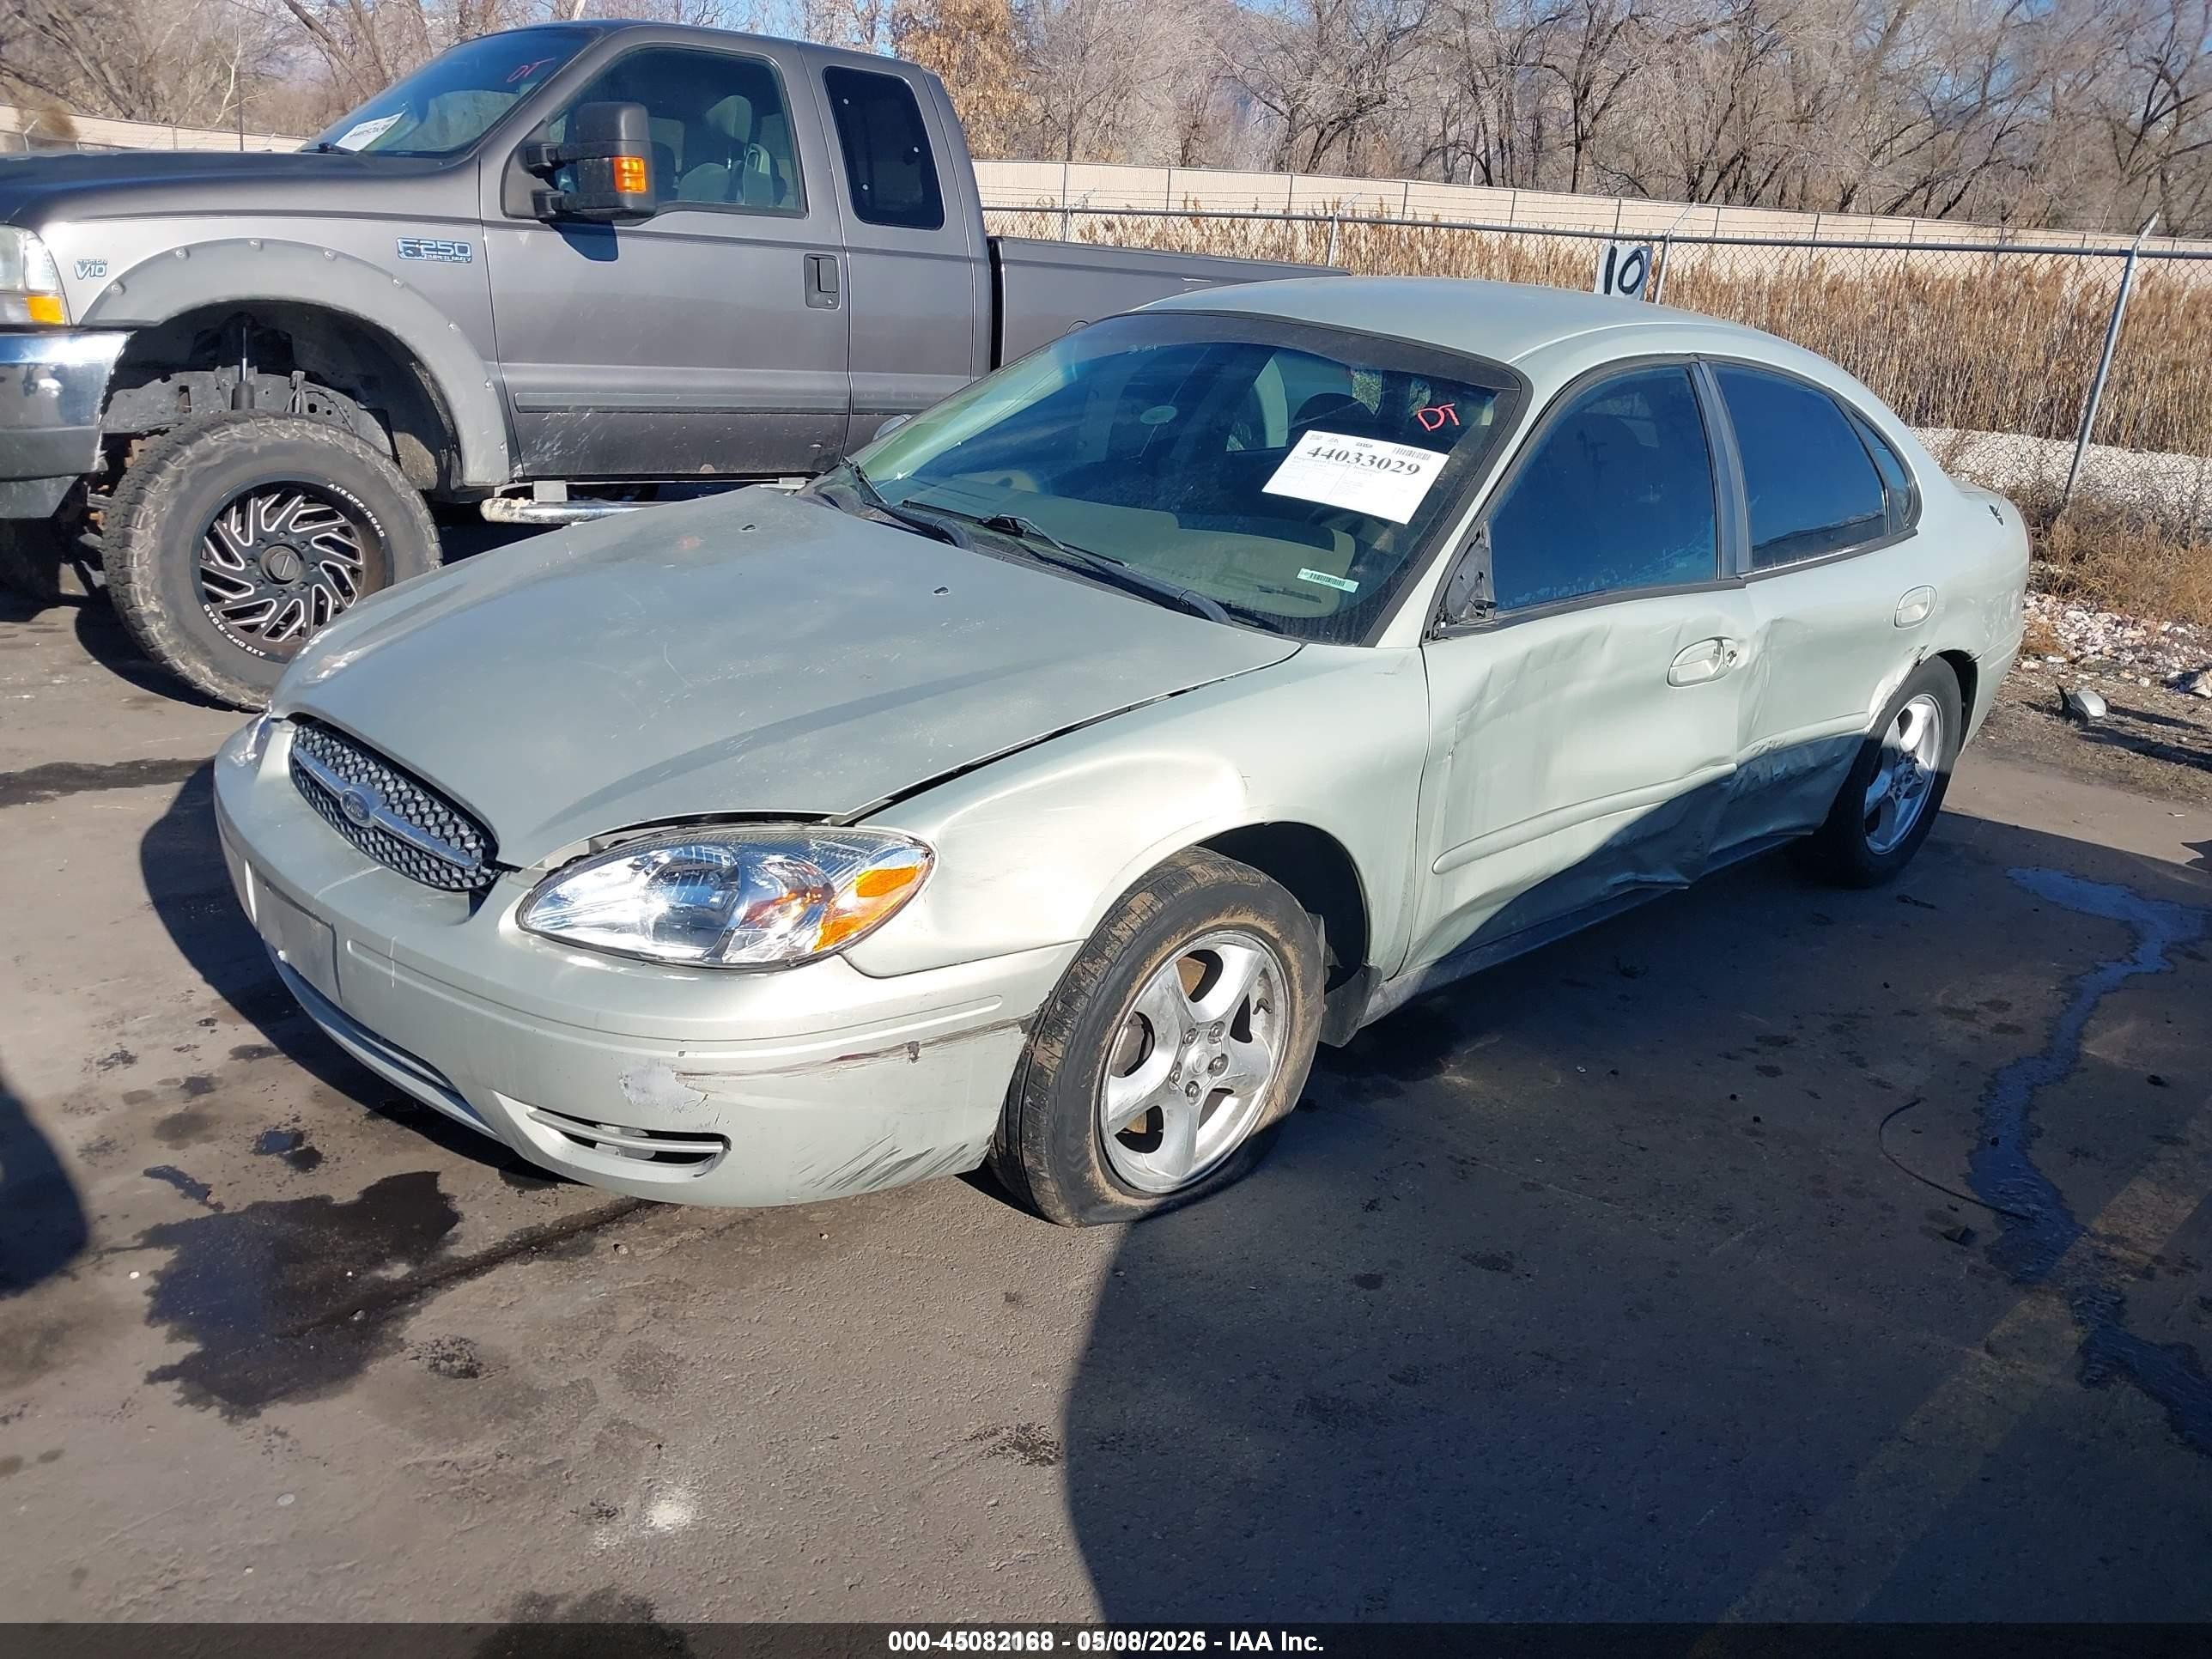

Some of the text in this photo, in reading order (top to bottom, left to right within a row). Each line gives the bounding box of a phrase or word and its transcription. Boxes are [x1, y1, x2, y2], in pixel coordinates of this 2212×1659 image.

[74, 264, 106, 280] V10
[1603, 245, 1644, 295] 10
[1306, 445, 1421, 477] 44033029
